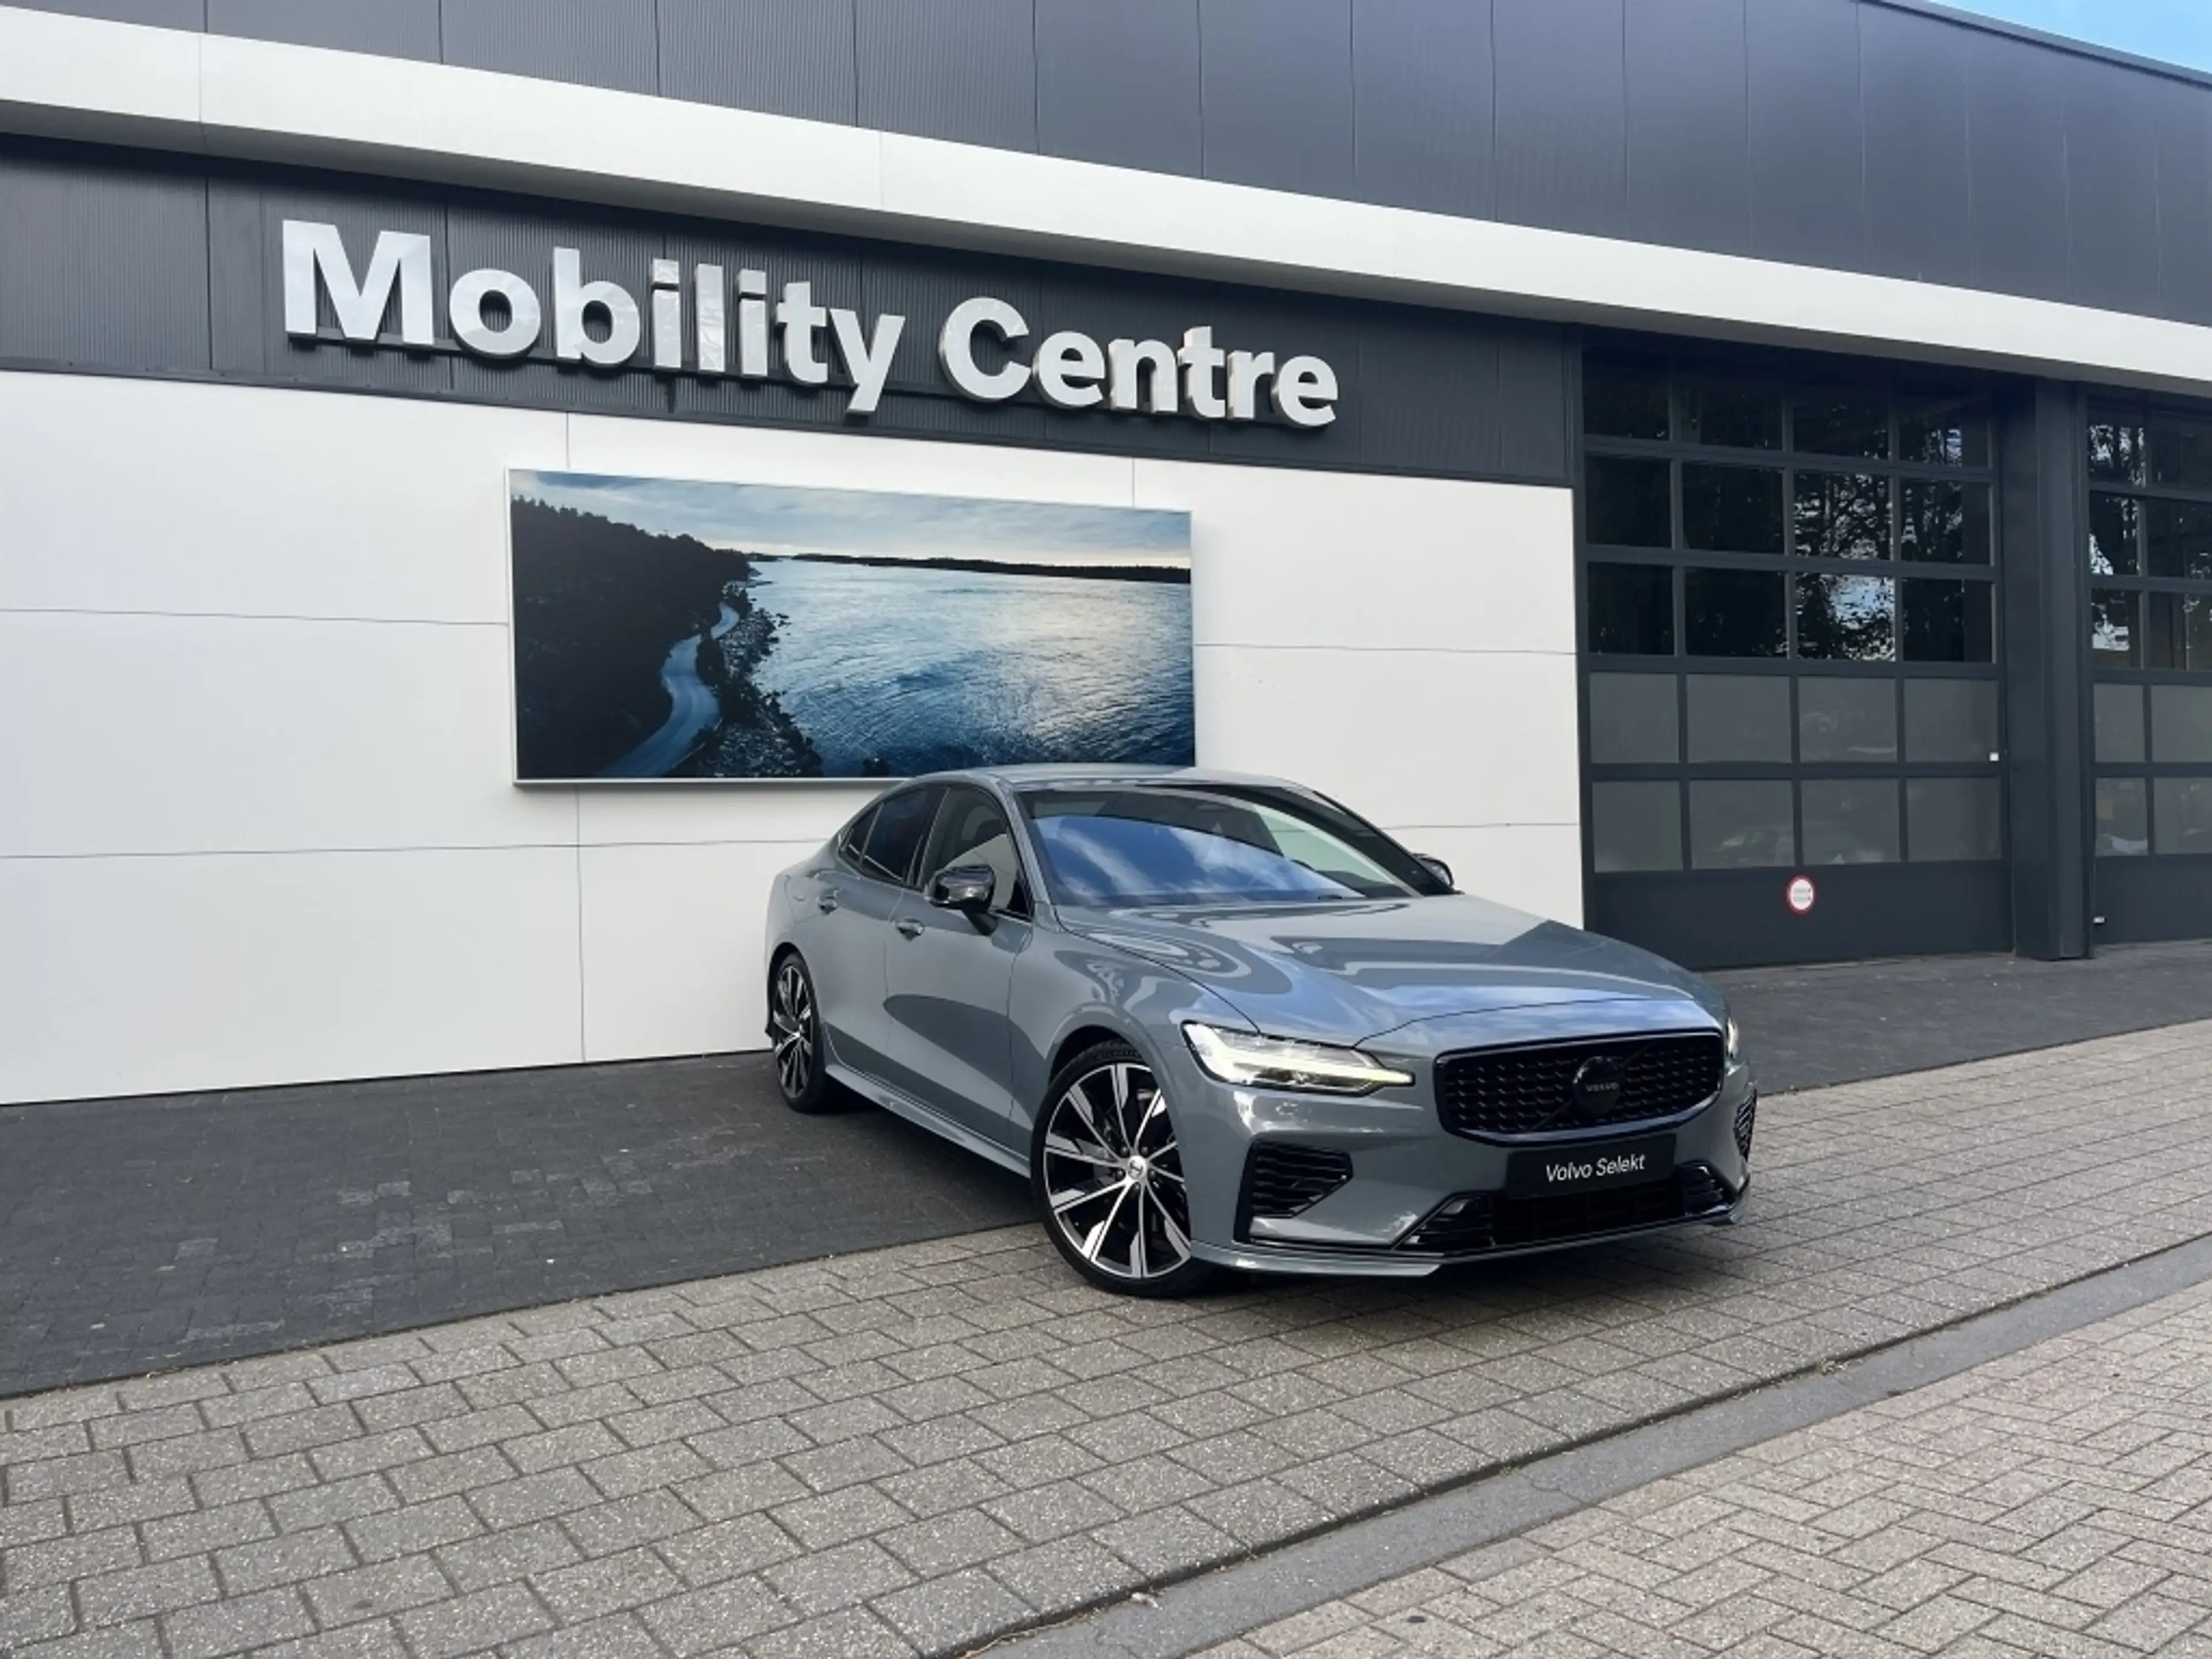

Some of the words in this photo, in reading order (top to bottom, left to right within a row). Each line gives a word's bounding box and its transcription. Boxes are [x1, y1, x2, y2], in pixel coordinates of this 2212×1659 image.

[282, 219, 905, 414] Mobility
[939, 297, 1338, 427] Centre
[1546, 1162, 1592, 1182] Volvo
[1596, 1153, 1645, 1176] Selekt
